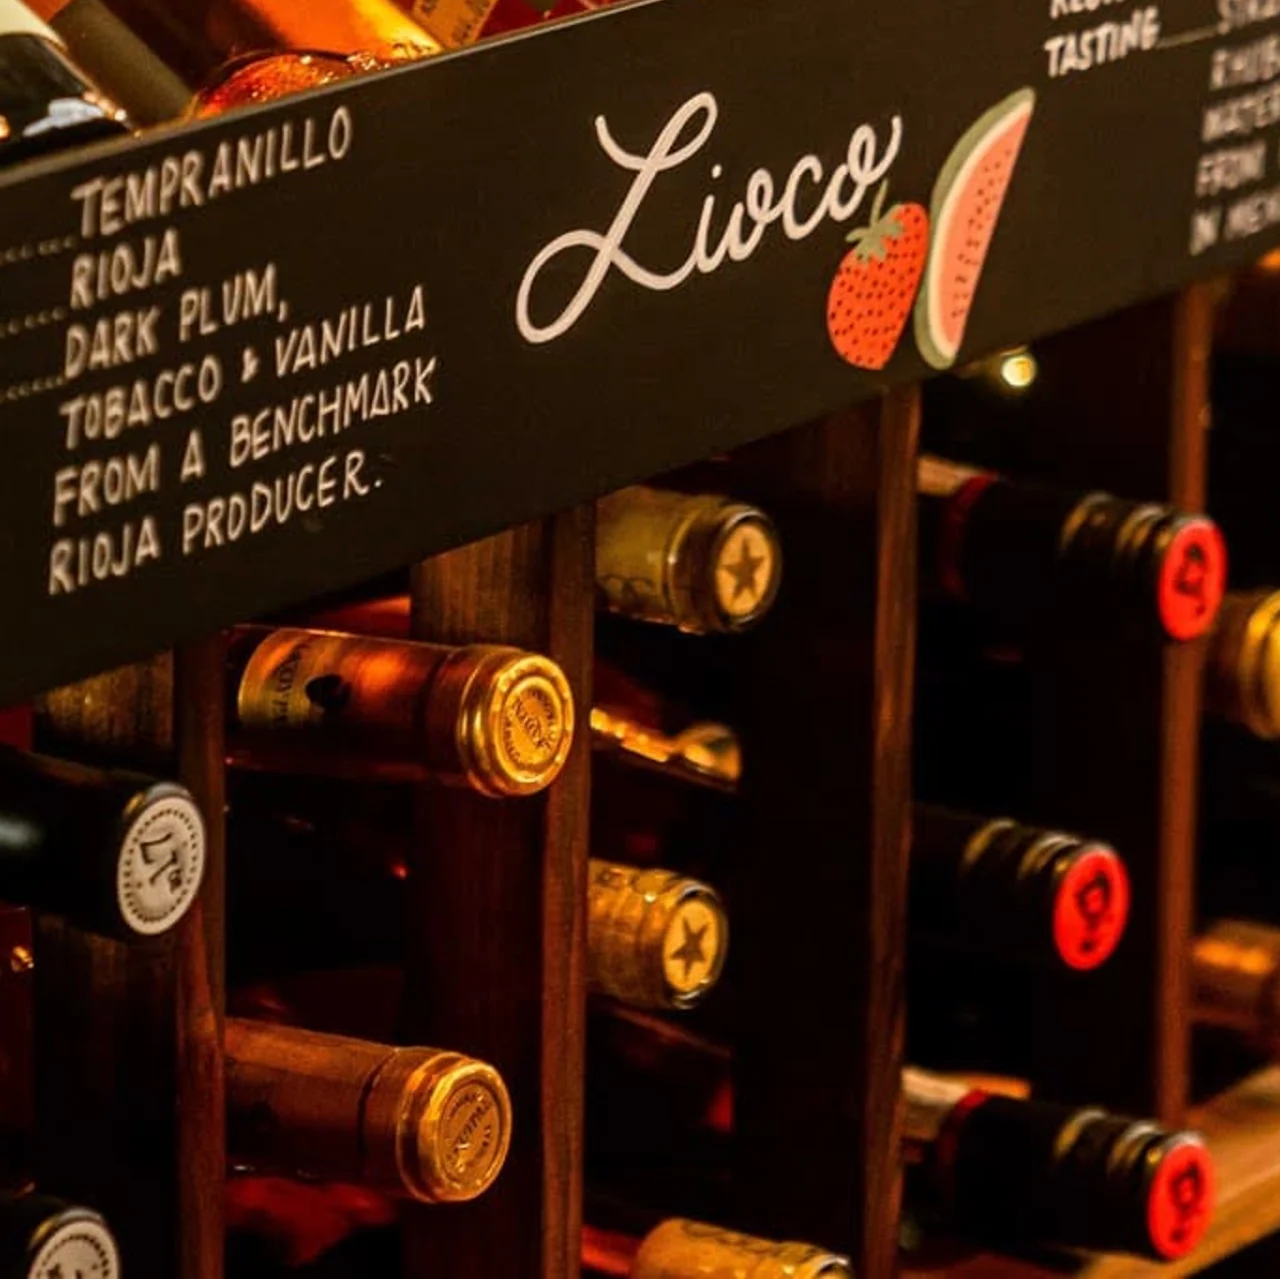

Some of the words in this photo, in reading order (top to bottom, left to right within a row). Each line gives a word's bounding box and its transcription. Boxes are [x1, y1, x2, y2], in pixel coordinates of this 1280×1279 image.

[1043, 6, 1160, 78] TASTING
[70, 105, 353, 238] TEMPRANILLO
[516, 91, 902, 343] Lioco
[1196, 140, 1266, 196] FROM
[63, 304, 160, 380] DARK
[179, 262, 289, 342] PLUM,
[69, 228, 183, 310] RIOJA
[60, 355, 222, 451] TOBACCO
[274, 283, 426, 379] VANILLA
[52, 444, 160, 527] FROM
[180, 429, 206, 484] A
[228, 356, 438, 469] BENCHMARK
[48, 516, 159, 596] RIOJA
[182, 448, 382, 556] PRODUCER.
